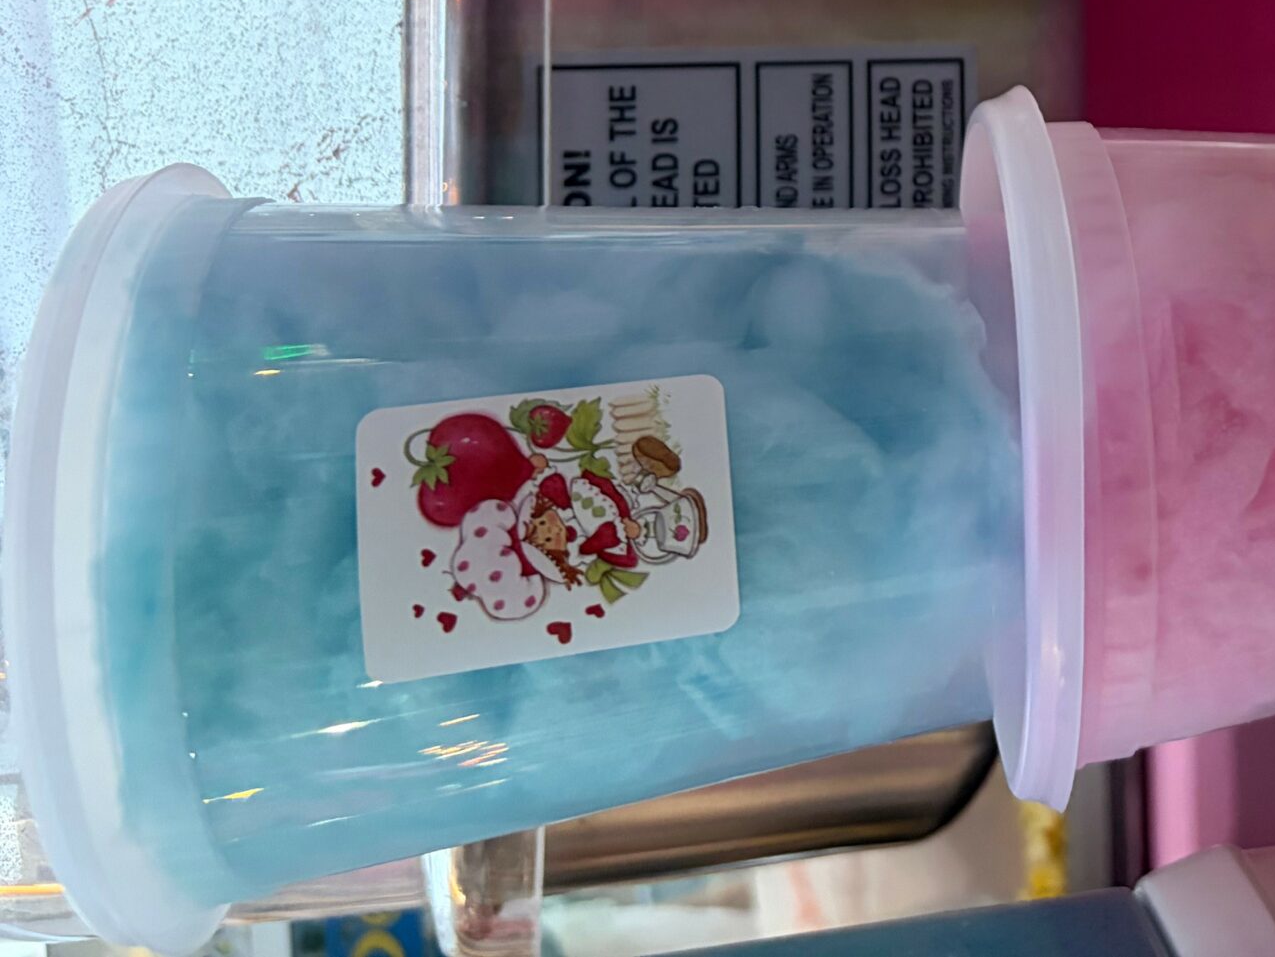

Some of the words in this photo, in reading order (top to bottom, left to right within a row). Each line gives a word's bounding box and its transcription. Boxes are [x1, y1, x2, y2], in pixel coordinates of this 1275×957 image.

[609, 85, 637, 142] THE
[651, 118, 679, 144] IS
[811, 73, 834, 170] OPERATION
[879, 77, 901, 140] HEAD
[775, 134, 799, 182] ARMS
[911, 79, 933, 207] ROHIBITED
[609, 151, 637, 189] OF
[811, 176, 834, 192] IN
